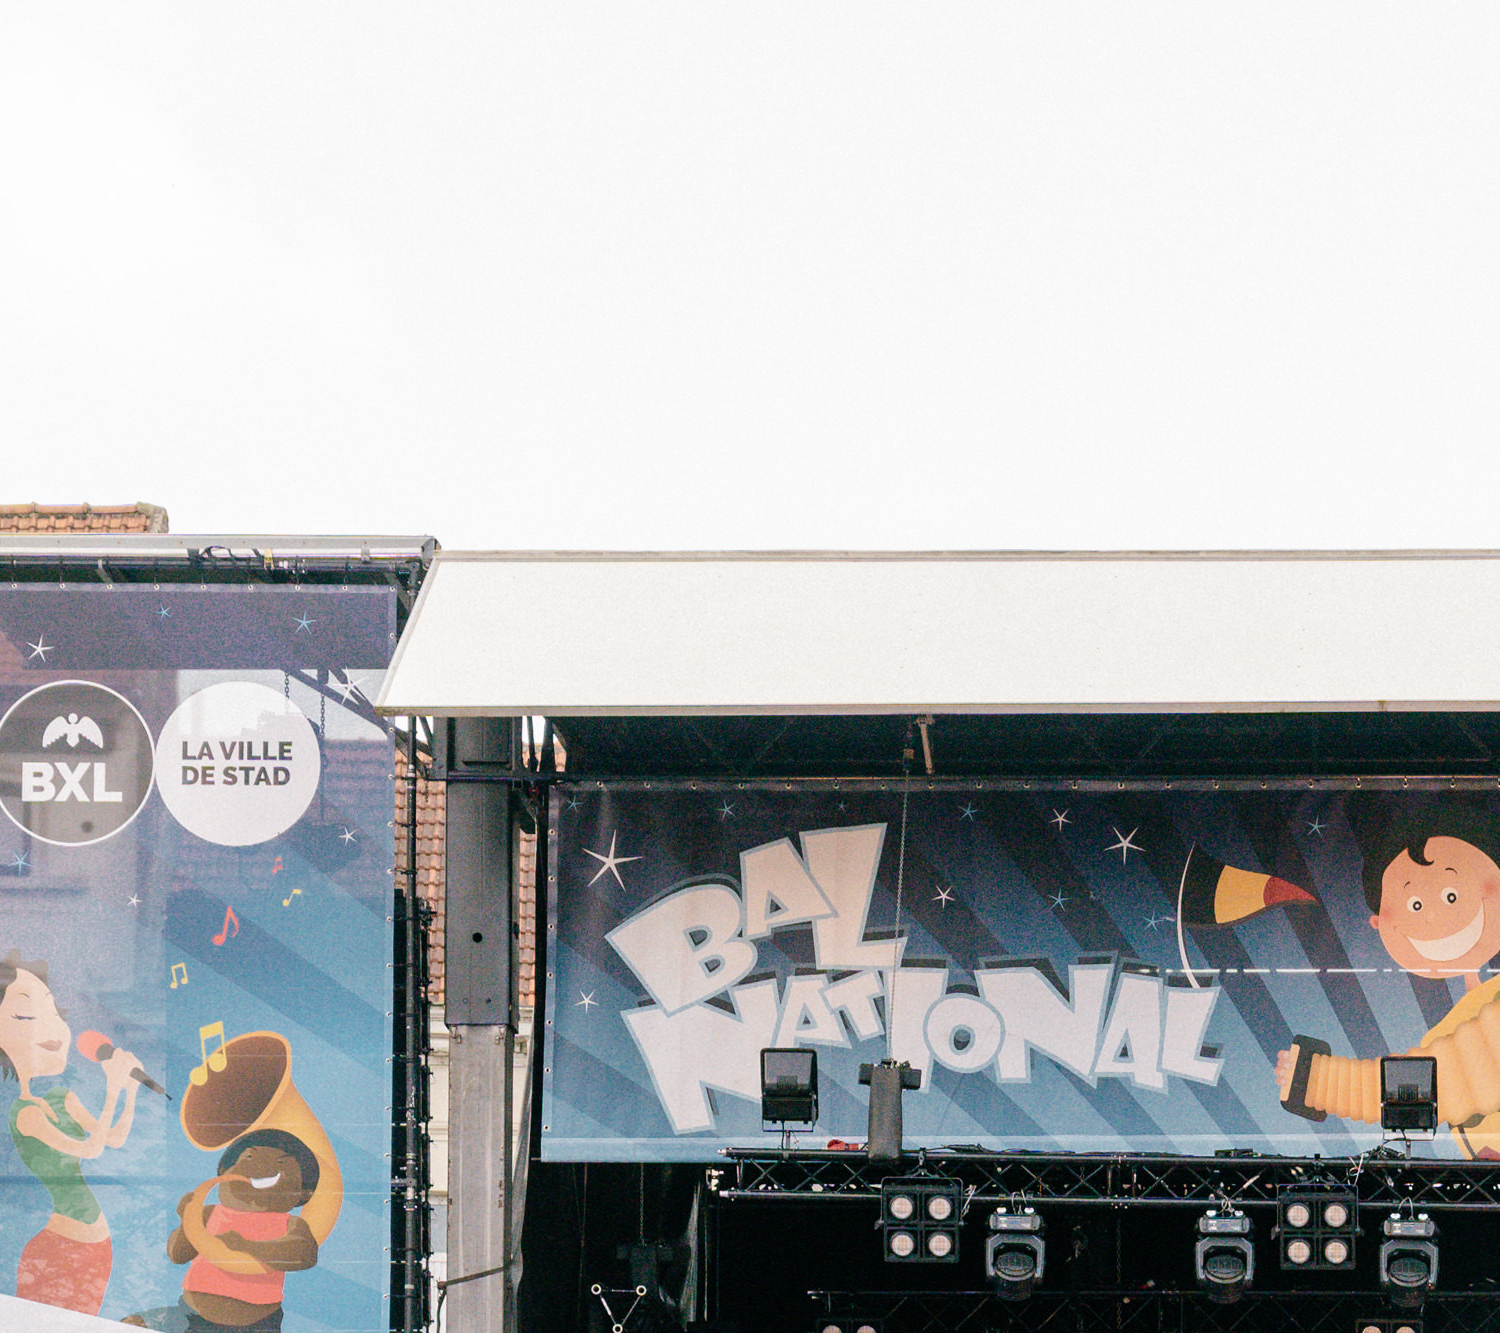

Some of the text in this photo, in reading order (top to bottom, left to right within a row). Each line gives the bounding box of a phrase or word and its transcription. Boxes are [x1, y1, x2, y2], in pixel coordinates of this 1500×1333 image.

[181, 740, 294, 762] LA VILLE
[21, 762, 124, 803] BXL
[181, 766, 292, 786] DE STAD
[605, 822, 908, 1017] BAL
[621, 963, 1224, 1135] NATIONAL
